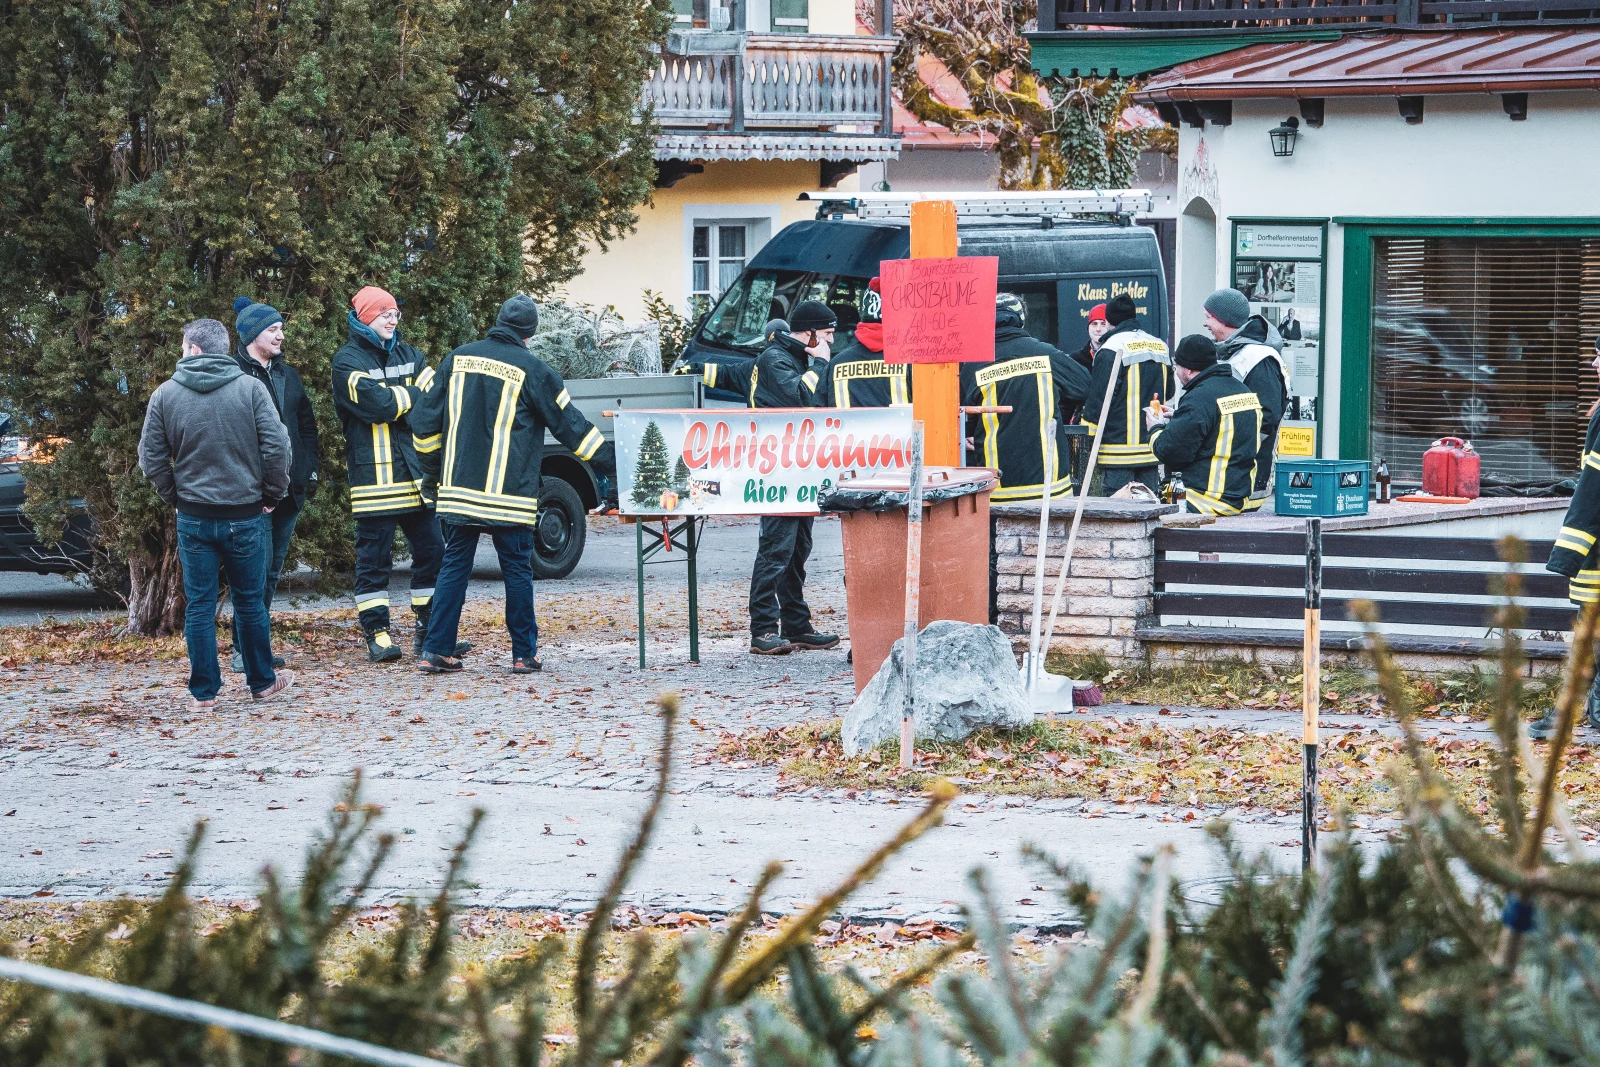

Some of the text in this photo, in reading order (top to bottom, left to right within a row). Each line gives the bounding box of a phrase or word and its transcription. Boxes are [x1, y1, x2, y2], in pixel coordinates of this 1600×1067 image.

[1257, 234, 1319, 242] Dorfhelferinnenstation
[891, 277, 979, 311] CHRISTBÄUME
[1078, 283, 1107, 301] Klaus
[484, 361, 521, 382] BAYRISCHZELL
[835, 362, 904, 379] FEUERWEHR
[980, 360, 1047, 382] FEUERWEHR BAYRISCHZELL
[1281, 431, 1311, 442] Frühling
[743, 478, 787, 503] hier
[1345, 494, 1364, 502] Brauhaus
[1345, 502, 1364, 510] Tegernsee
